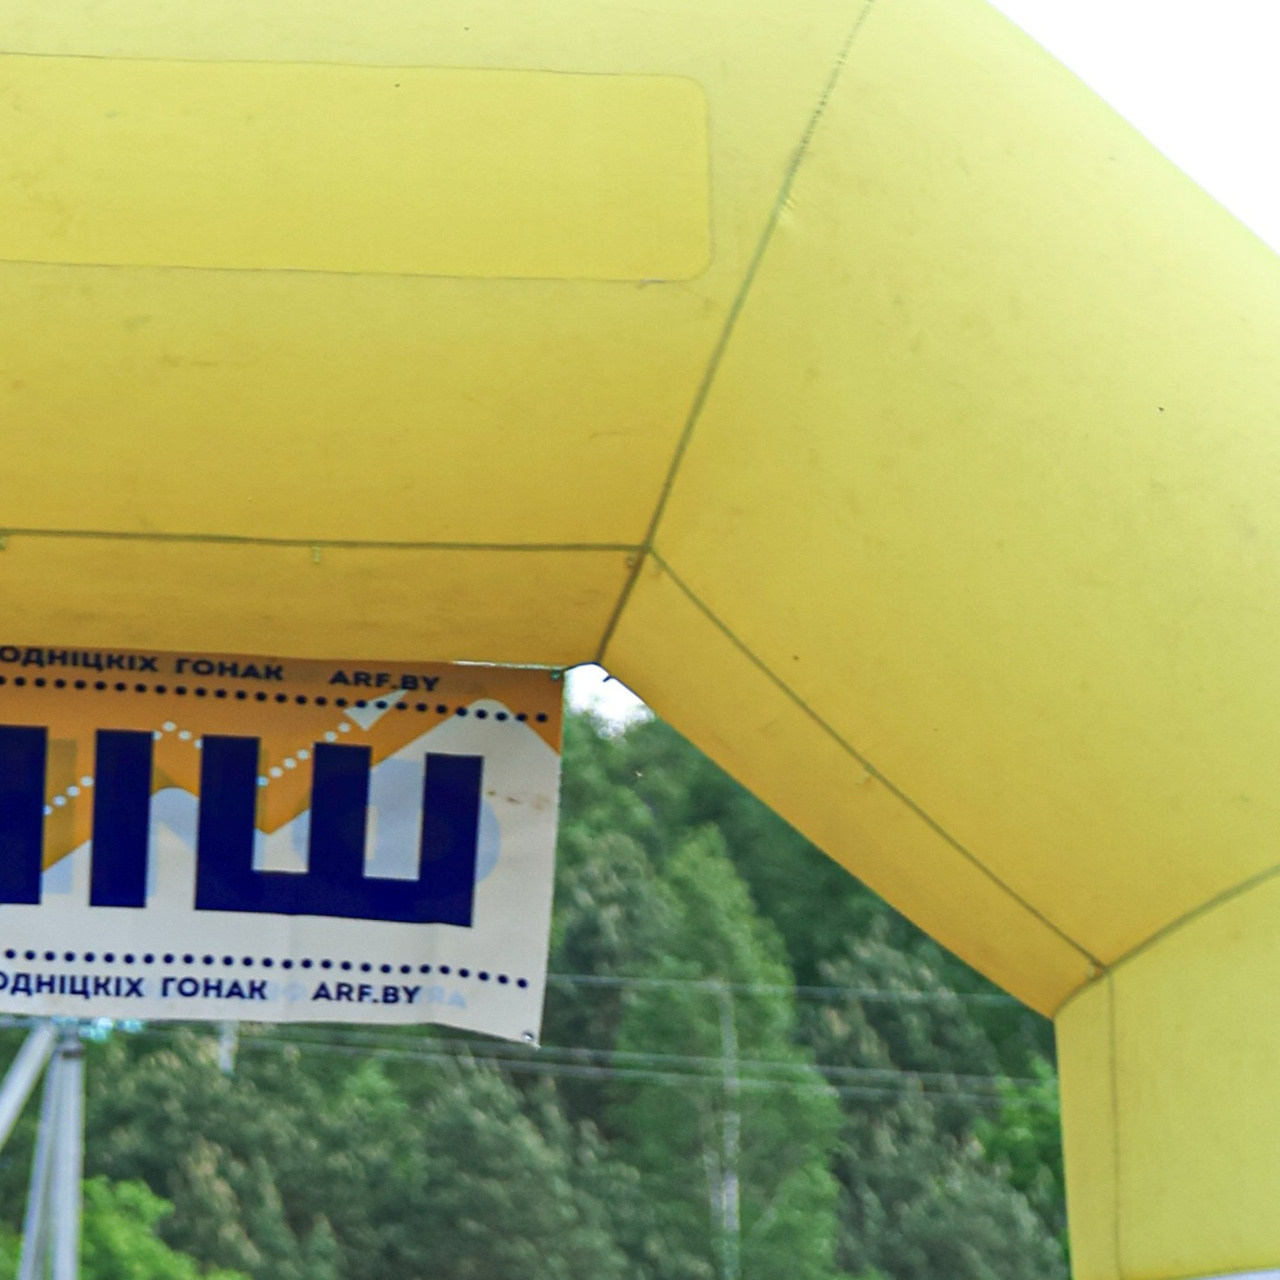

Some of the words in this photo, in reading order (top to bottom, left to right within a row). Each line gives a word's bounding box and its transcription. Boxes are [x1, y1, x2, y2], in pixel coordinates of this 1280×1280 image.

[175, 656, 284, 682] ГОНАК
[329, 668, 440, 693] ARF.BY
[160, 976, 268, 1001] ГОНАК
[311, 981, 422, 1005] ARF.BY
